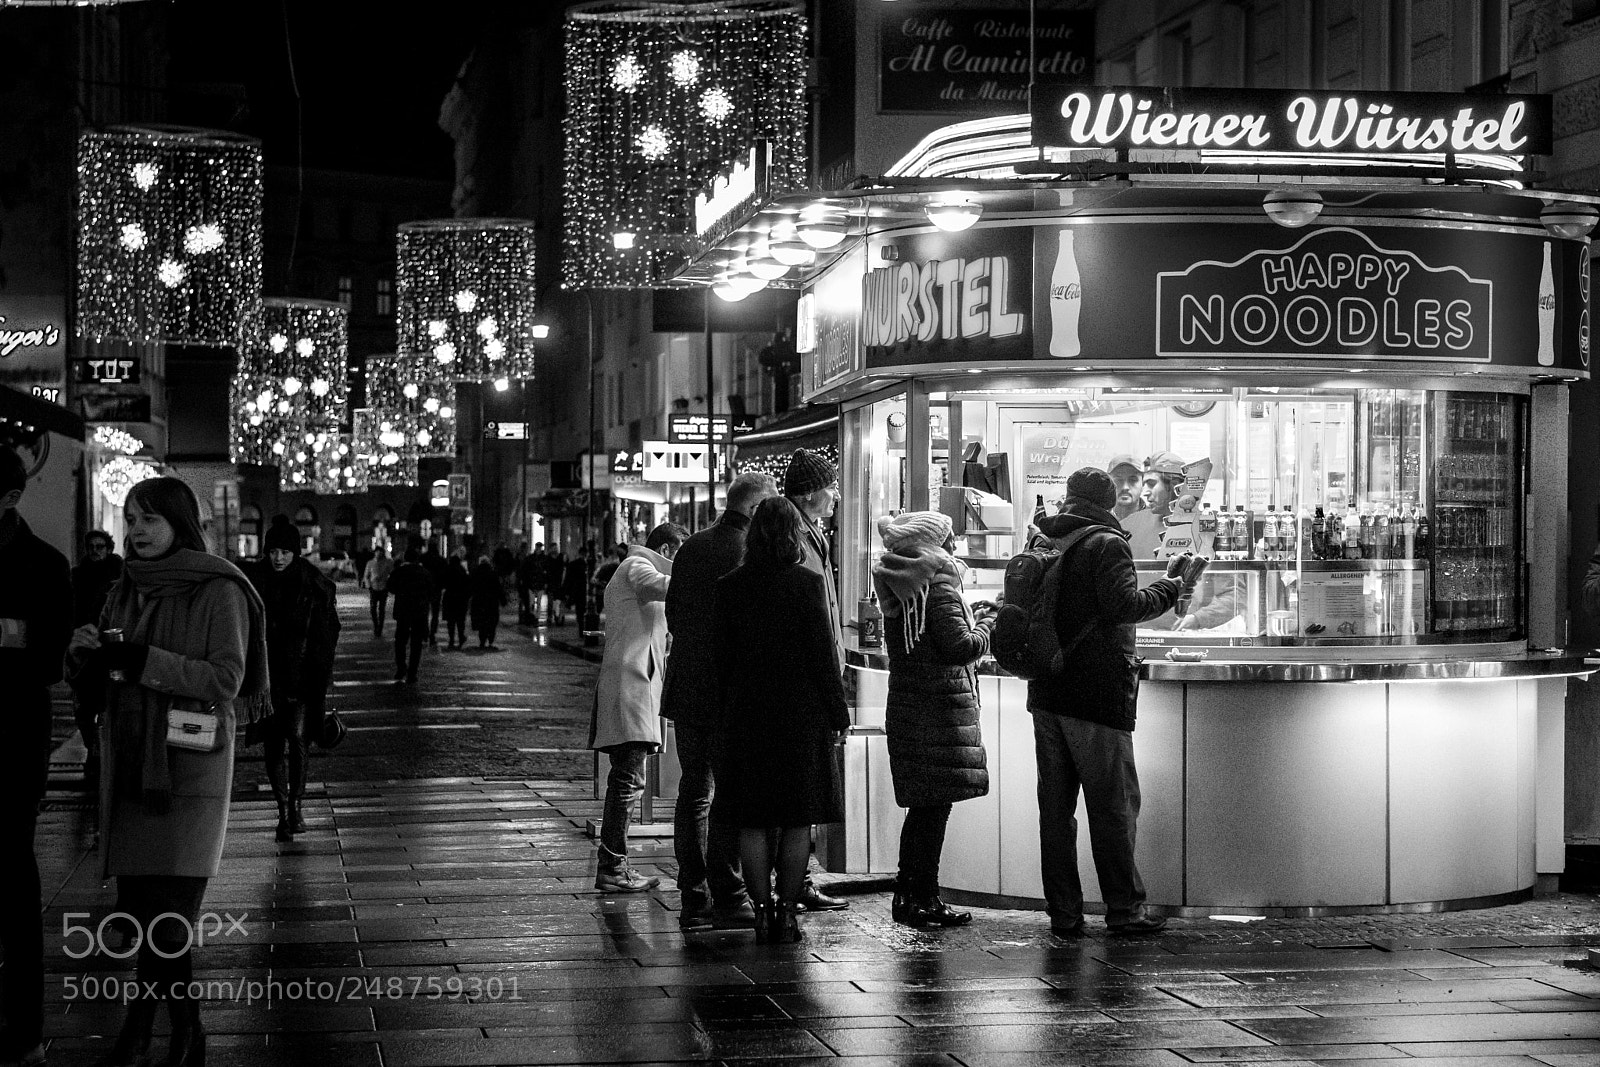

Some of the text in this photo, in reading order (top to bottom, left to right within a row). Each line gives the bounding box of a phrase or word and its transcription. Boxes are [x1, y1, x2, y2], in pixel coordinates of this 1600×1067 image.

[889, 45, 936, 72] Al
[940, 81, 965, 101] da
[1061, 92, 1528, 151] Wiener Würstel
[1262, 252, 1411, 296] HAPPY
[1179, 294, 1474, 350] NOODLES
[1030, 453, 1071, 466] Wrap
